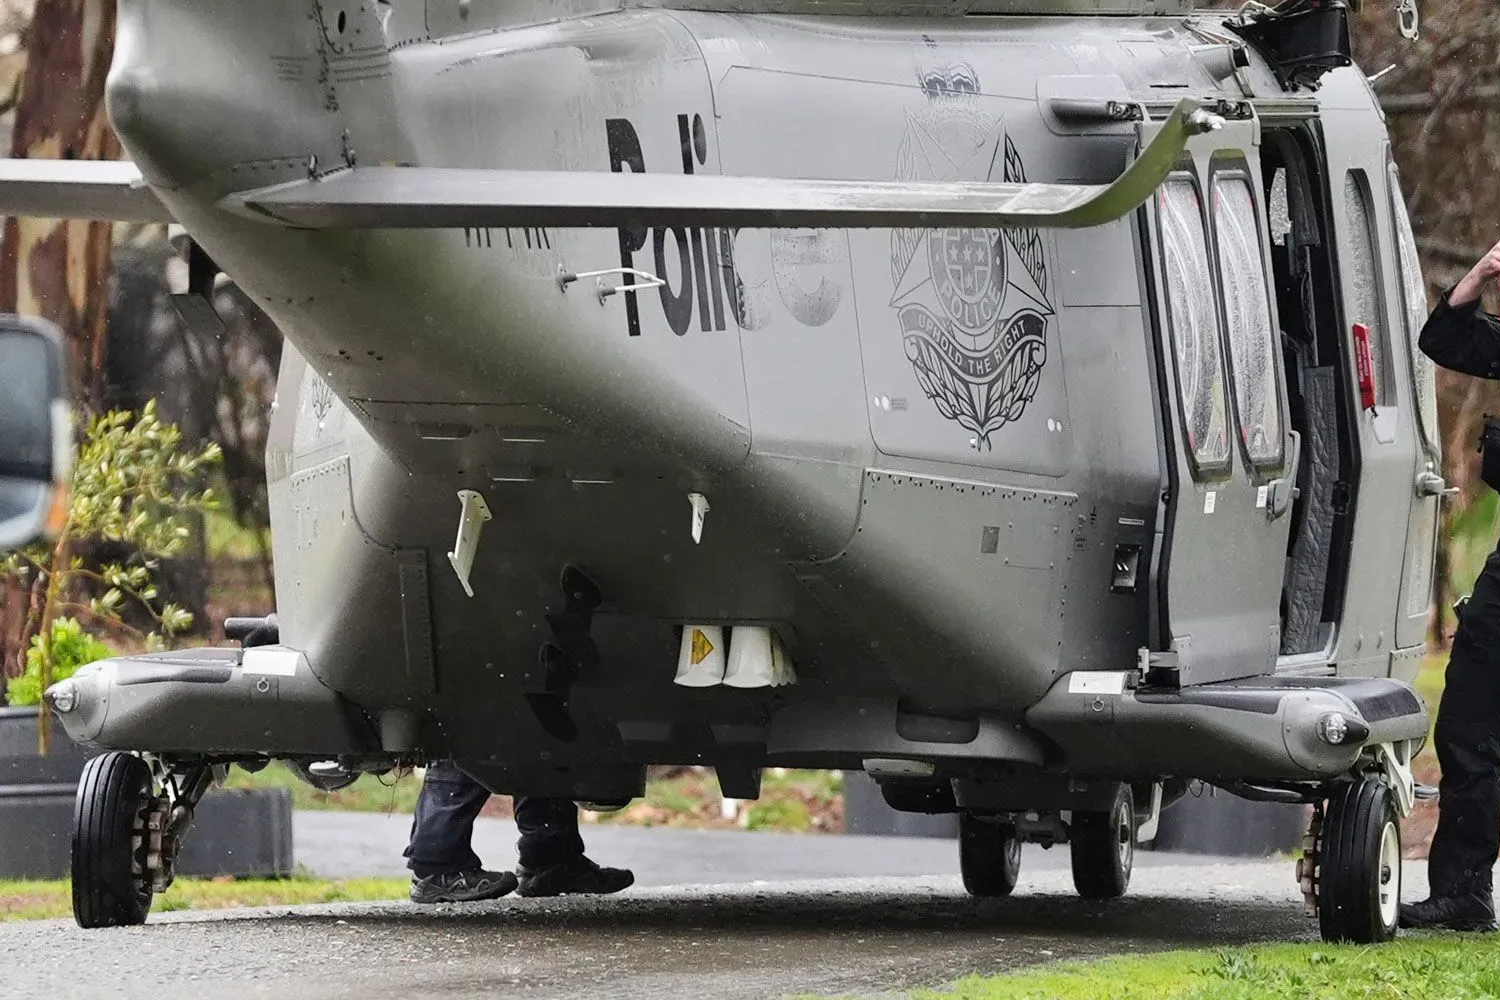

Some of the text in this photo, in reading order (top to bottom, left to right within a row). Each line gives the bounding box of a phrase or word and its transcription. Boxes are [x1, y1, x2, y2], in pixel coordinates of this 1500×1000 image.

[940, 280, 1001, 327] POLICE
[918, 313, 1026, 375] UPHOLD THE RIGHT
